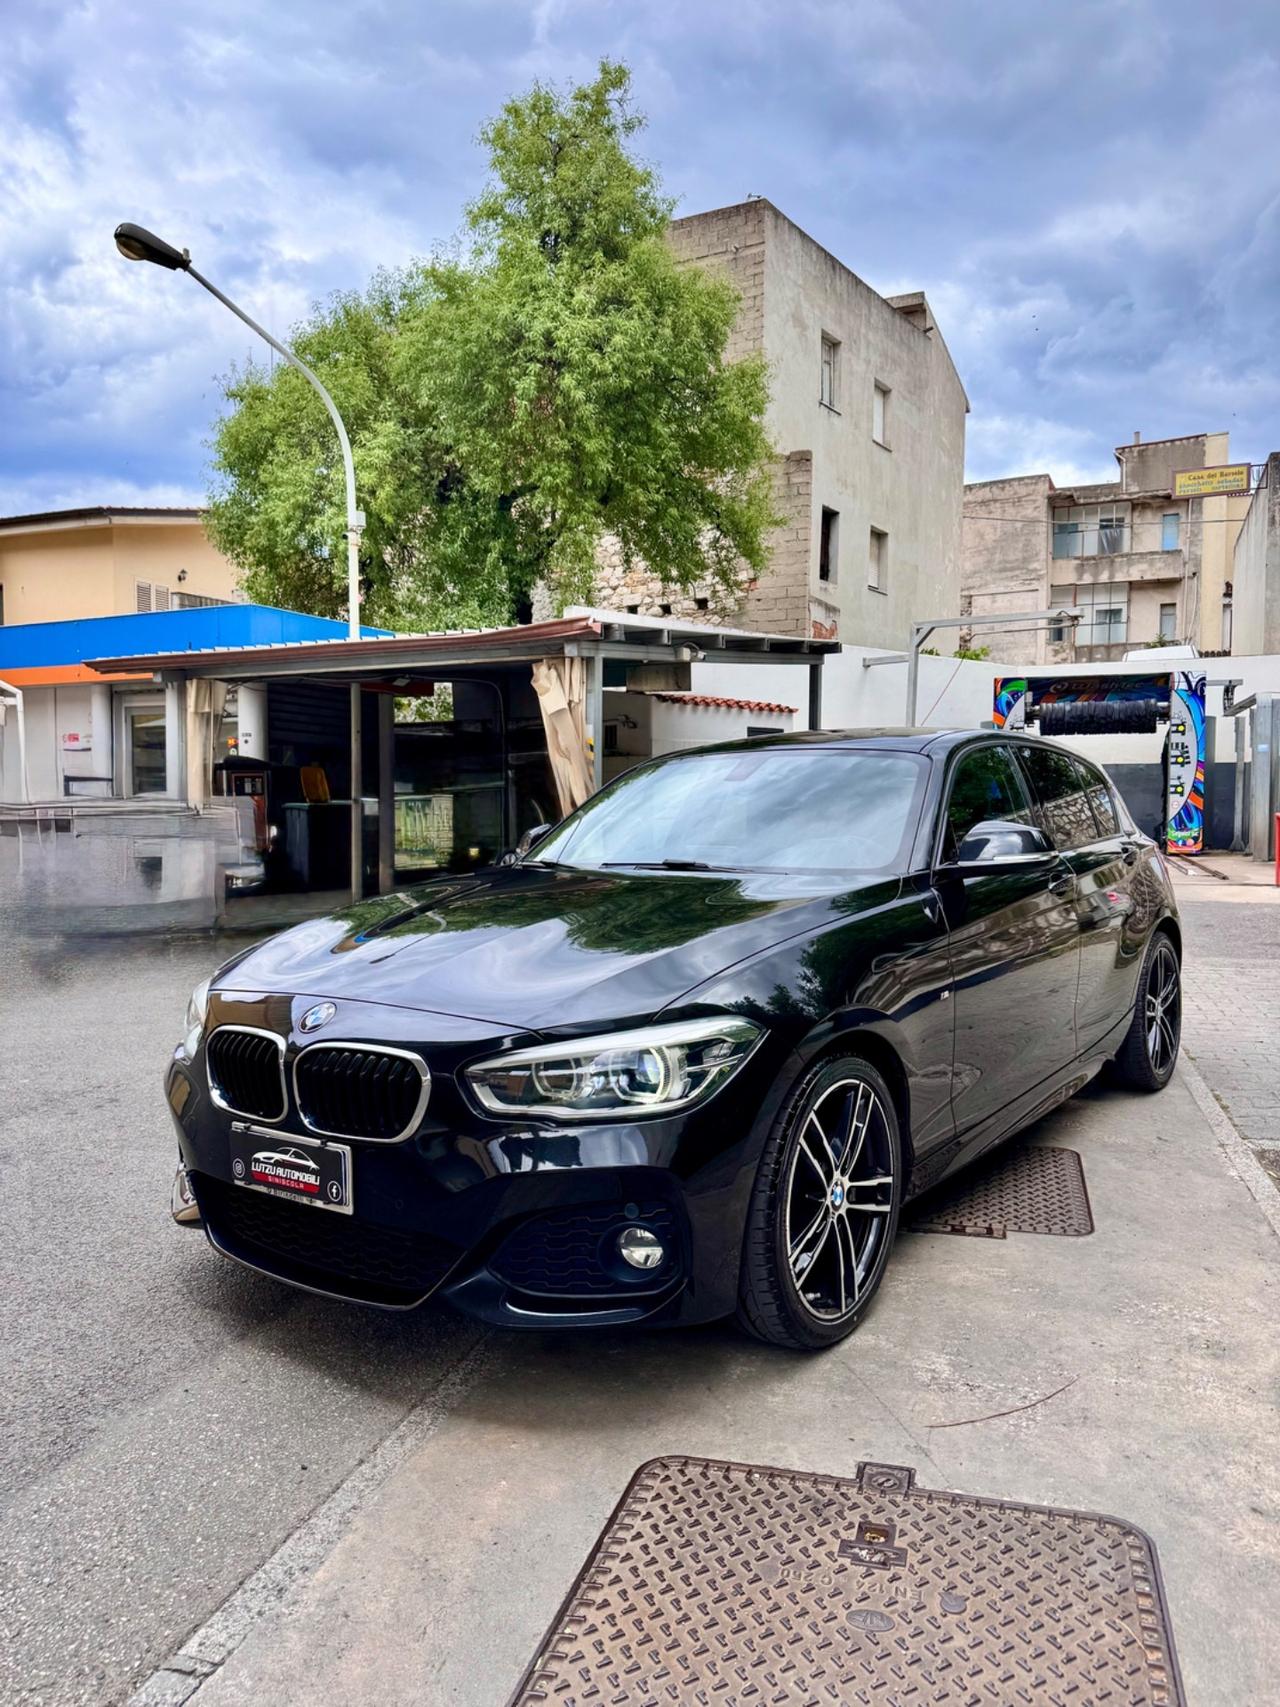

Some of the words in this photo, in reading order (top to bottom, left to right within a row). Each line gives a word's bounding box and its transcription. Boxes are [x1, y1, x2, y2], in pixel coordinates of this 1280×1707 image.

[251, 1161, 276, 1176] LUTZU
[276, 1167, 320, 1186] AUTOMOBILI
[268, 1175, 305, 1190] SINISCOLA
